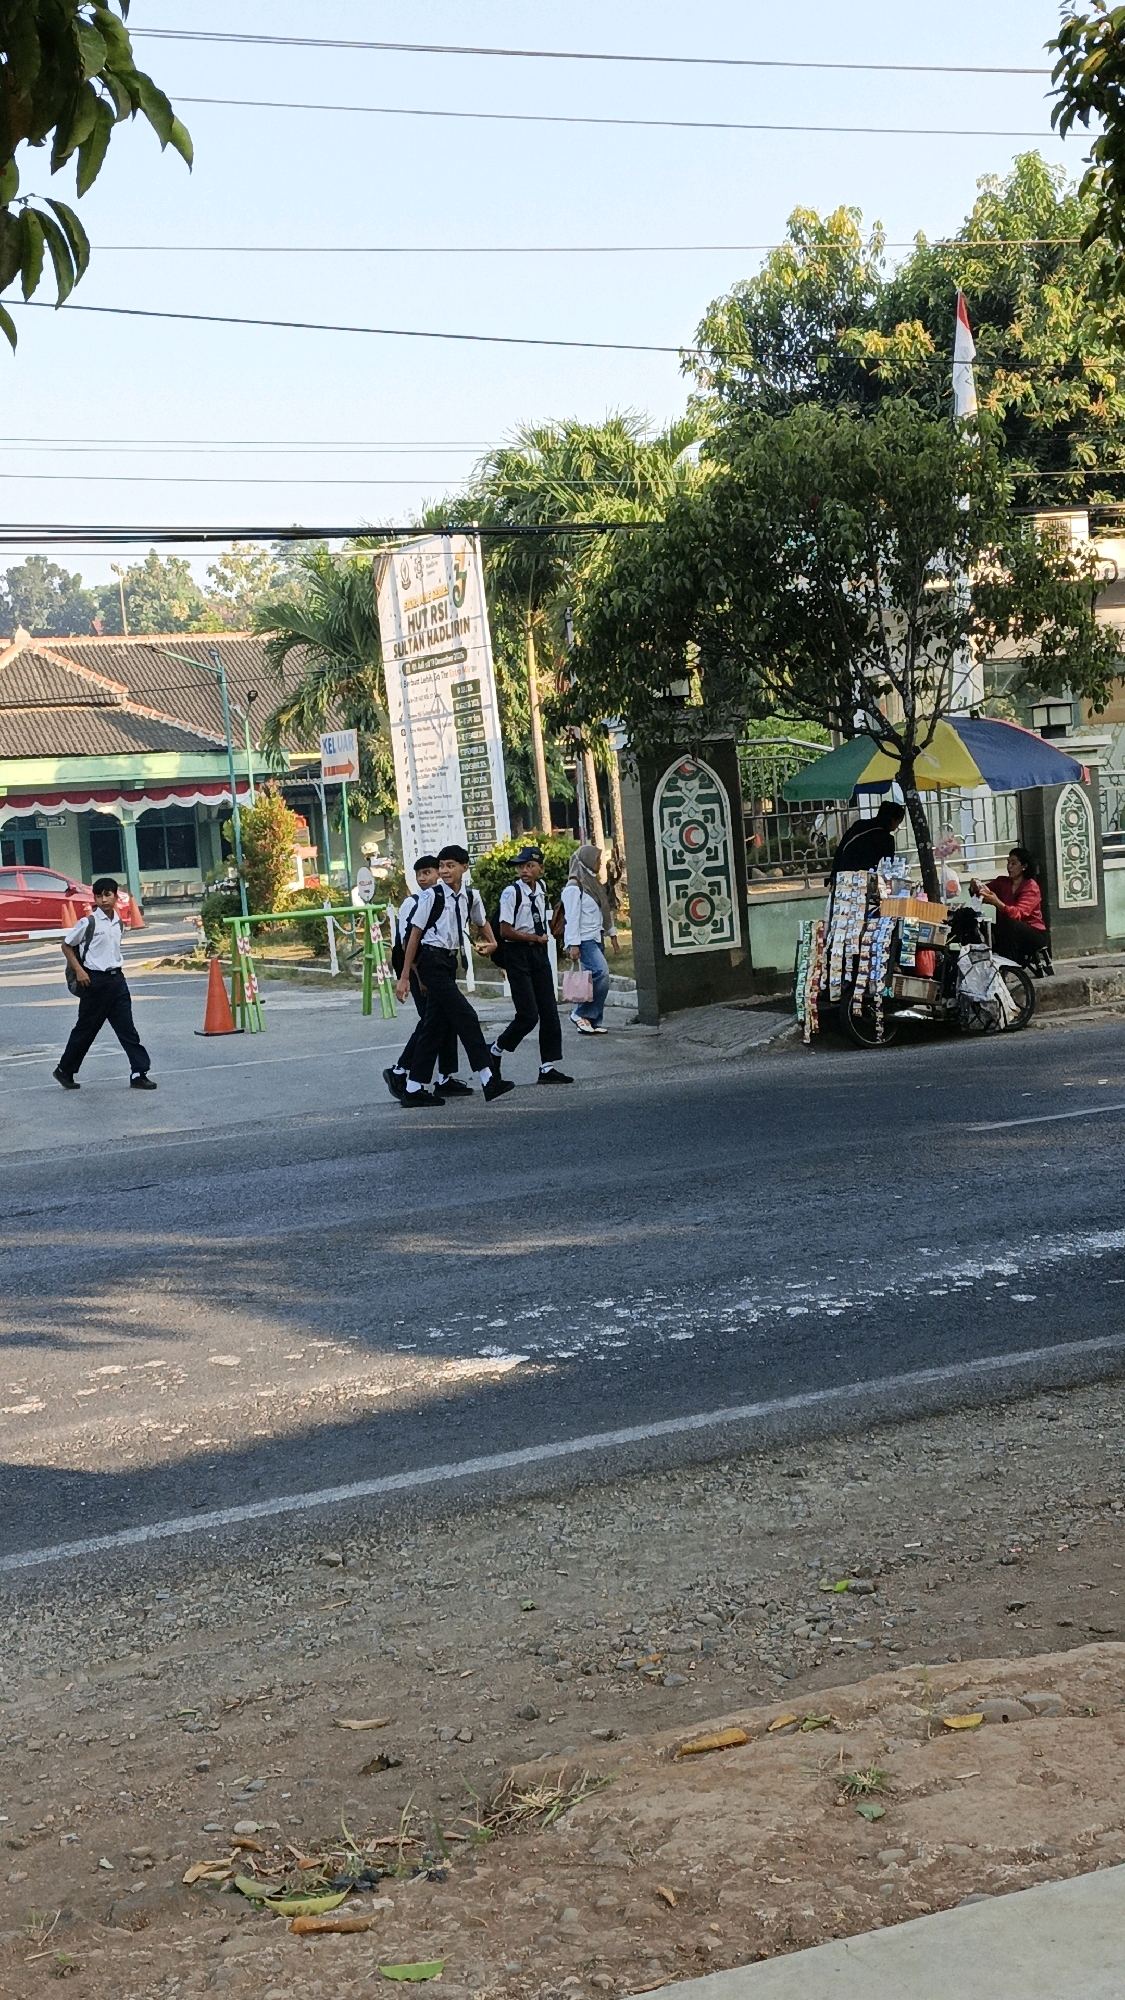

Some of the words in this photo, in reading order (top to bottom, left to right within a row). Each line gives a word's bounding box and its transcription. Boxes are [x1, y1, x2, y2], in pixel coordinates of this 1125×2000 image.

[408, 607, 428, 635] HUT
[431, 600, 448, 626] RSI
[394, 631, 425, 658] SULTAN
[427, 616, 470, 648] HADLIRIN
[322, 734, 354, 754] KELUAR
